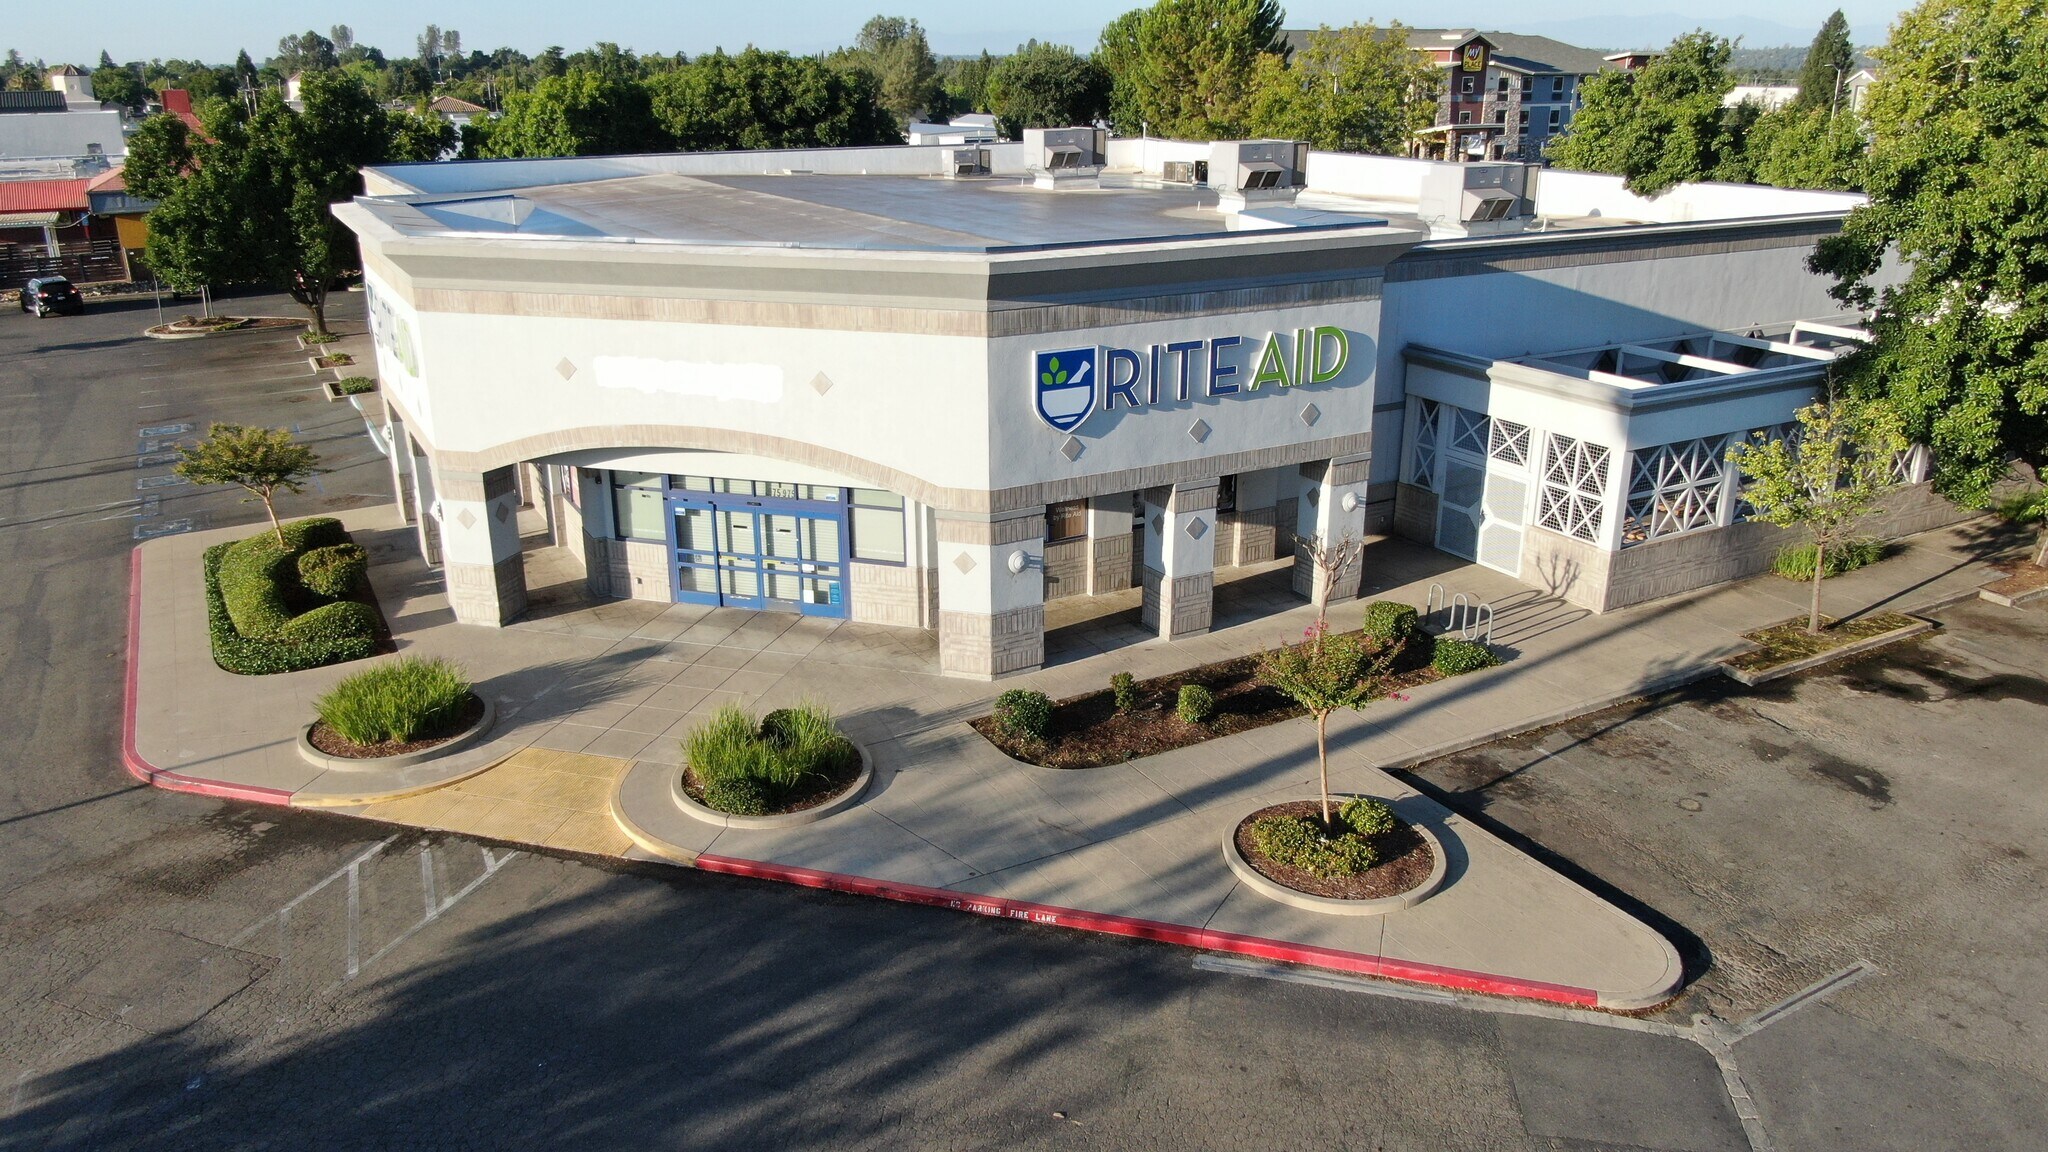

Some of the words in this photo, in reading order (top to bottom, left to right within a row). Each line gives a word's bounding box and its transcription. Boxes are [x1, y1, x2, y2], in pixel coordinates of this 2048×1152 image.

[1103, 335, 1243, 411] RITE
[1248, 325, 1349, 392] AID
[1010, 909, 1029, 919] FIRE
[1035, 913, 1057, 923] LANE
